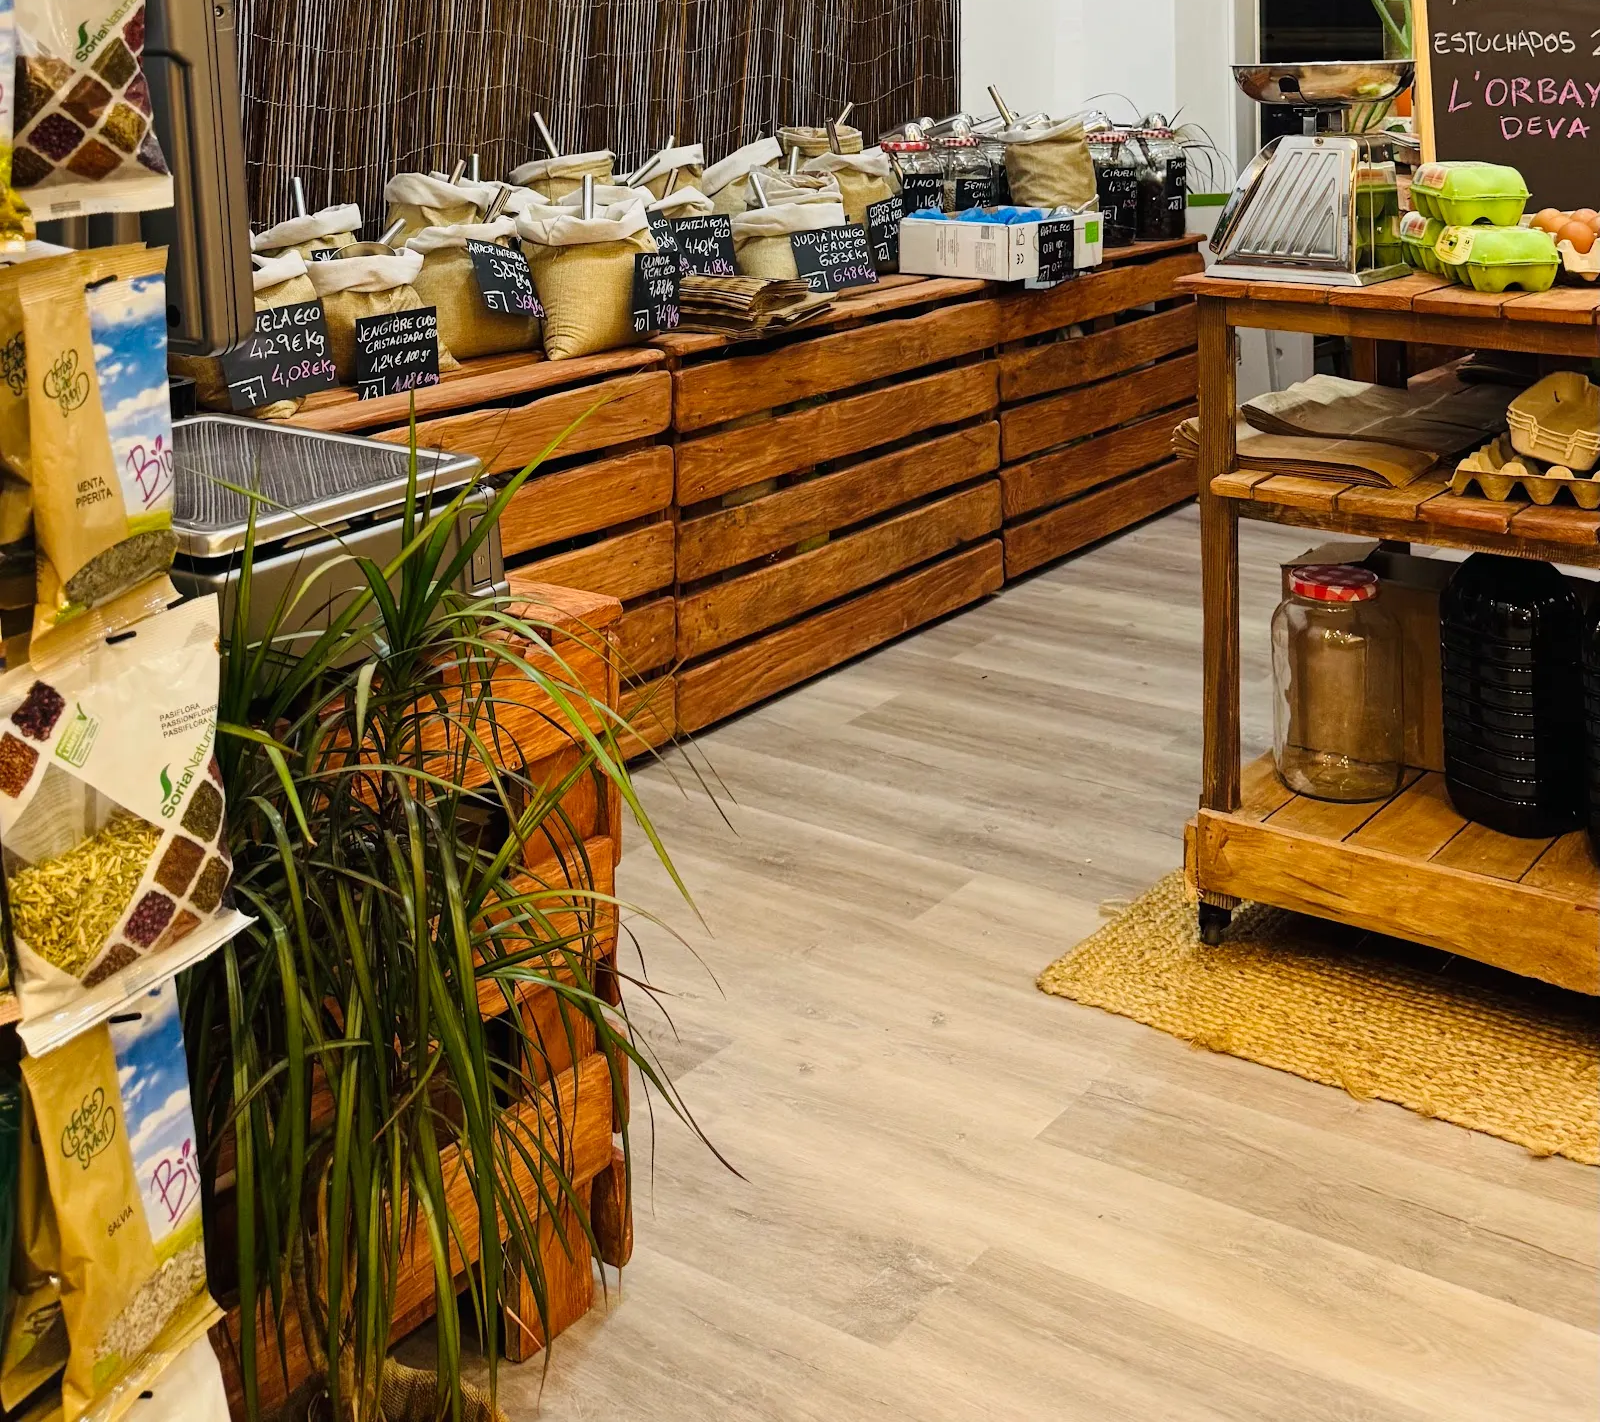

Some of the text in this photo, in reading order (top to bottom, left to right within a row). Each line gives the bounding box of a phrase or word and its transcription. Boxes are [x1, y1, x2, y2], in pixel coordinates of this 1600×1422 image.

[1433, 29, 1576, 58] ESTUCHADOS
[1500, 115, 1591, 141] DEVA
[713, 228, 730, 238] ECO
[815, 241, 853, 253] VERDE
[77, 476, 106, 493] MENTA
[75, 487, 113, 509] PIPERITA
[159, 702, 201, 722] PASIFLORA
[161, 717, 217, 819] SoriaNatural
[107, 1204, 134, 1238] SALVIA
